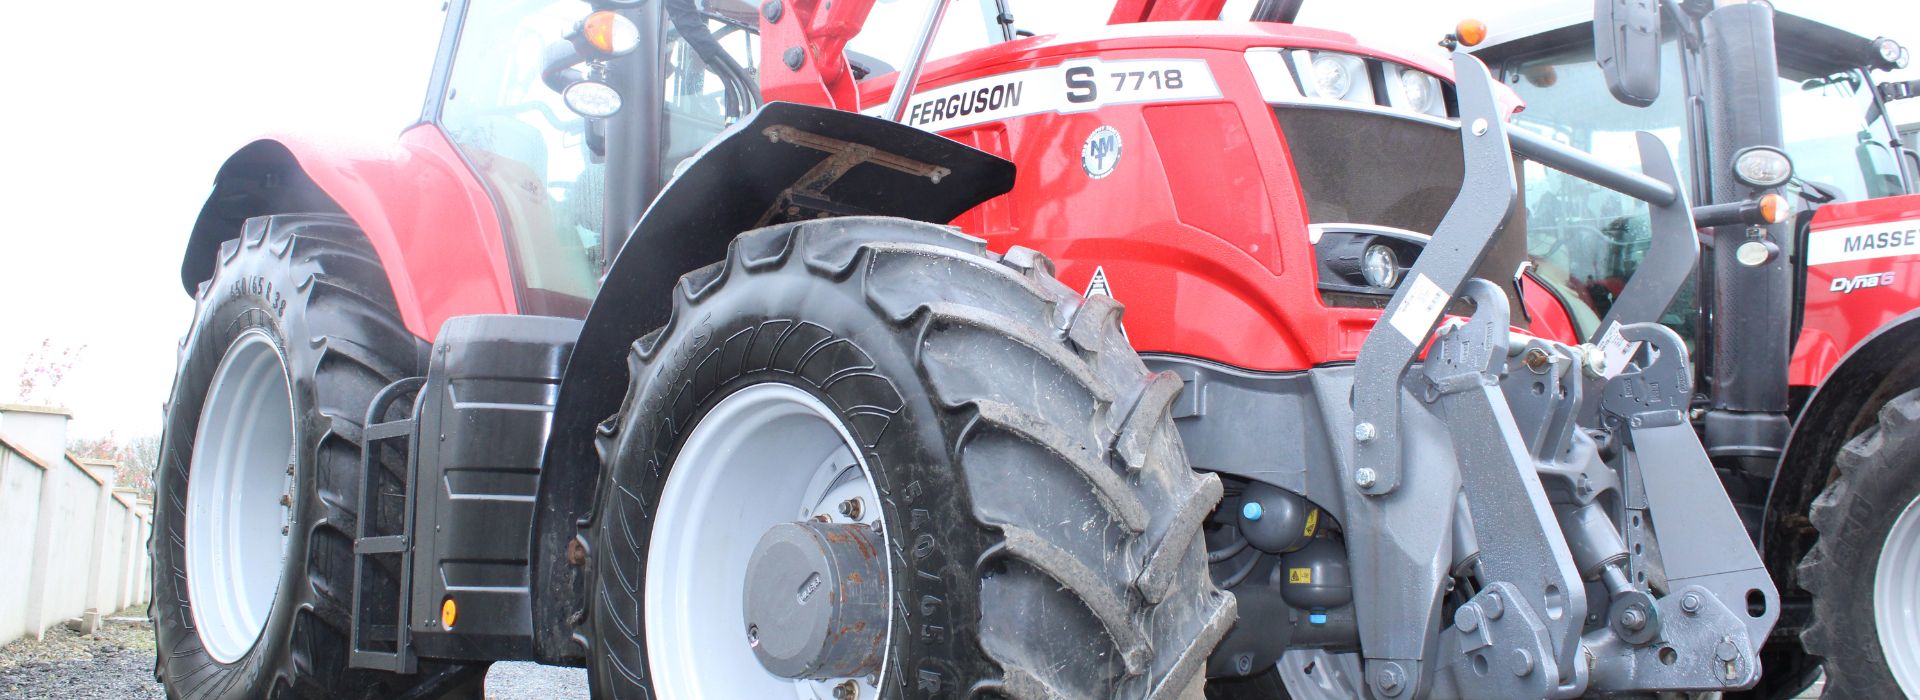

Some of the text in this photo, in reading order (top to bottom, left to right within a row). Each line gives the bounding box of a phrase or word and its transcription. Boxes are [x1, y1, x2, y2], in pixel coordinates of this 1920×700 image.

[909, 66, 1184, 126] FERGUSON S 7718
[1844, 228, 1920, 253] MASSE
[904, 480, 944, 644] 540/65
